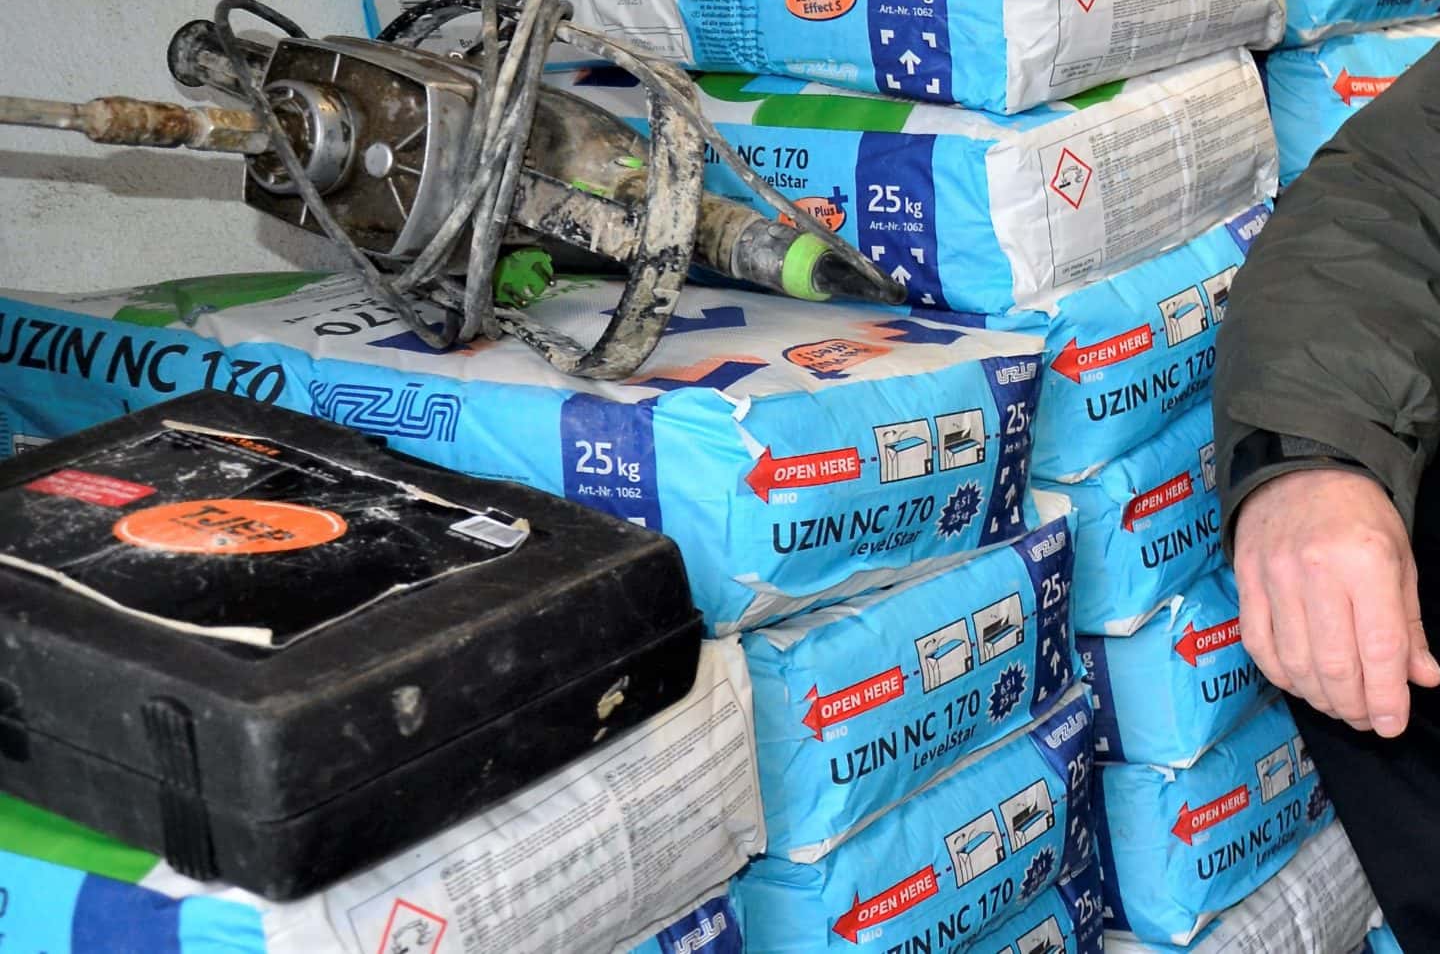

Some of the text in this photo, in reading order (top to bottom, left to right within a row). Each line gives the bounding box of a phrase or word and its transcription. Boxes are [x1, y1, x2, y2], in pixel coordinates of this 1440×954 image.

[803, 0, 843, 15] Effect S
[878, 4, 935, 18] Art.-Nr. 1062
[736, 145, 765, 168] NC
[772, 147, 810, 170] 170
[759, 171, 809, 190] velStar
[814, 206, 836, 217] Plus
[868, 183, 924, 219] 25 kg
[869, 220, 924, 233] Art.-Nr. 1062
[0, 312, 288, 406] UZIN NC 170
[1077, 331, 1150, 366] OPEN HERE
[1086, 346, 1216, 423] UZIN NC 170
[1005, 402, 1026, 436] 25
[575, 440, 641, 483] 25 kg
[774, 457, 857, 481] OPEN HERE
[578, 484, 643, 499] Art.-Nr. 1062
[1134, 477, 1191, 515] OPEN HERE
[772, 495, 935, 555] UZIN NC 170
[850, 530, 921, 557] LevelStar
[1141, 526, 1193, 570] UZIN
[1195, 508, 1220, 543] NC
[1041, 573, 1062, 610] 25
[1196, 631, 1227, 651] OPEN
[820, 677, 901, 720] OPEN HERE
[1201, 665, 1251, 704] UZIN
[829, 689, 981, 785] UZIN NC 170
[912, 723, 977, 772] LevelStar
[1067, 752, 1085, 790] 25
[1191, 792, 1248, 829] OPEN HERE
[1197, 801, 1300, 881] UZIN NC 170
[857, 876, 934, 923] OPEN HERE
[936, 905, 972, 946] NC
[976, 877, 1014, 919] 170
[1075, 890, 1095, 926] 25
